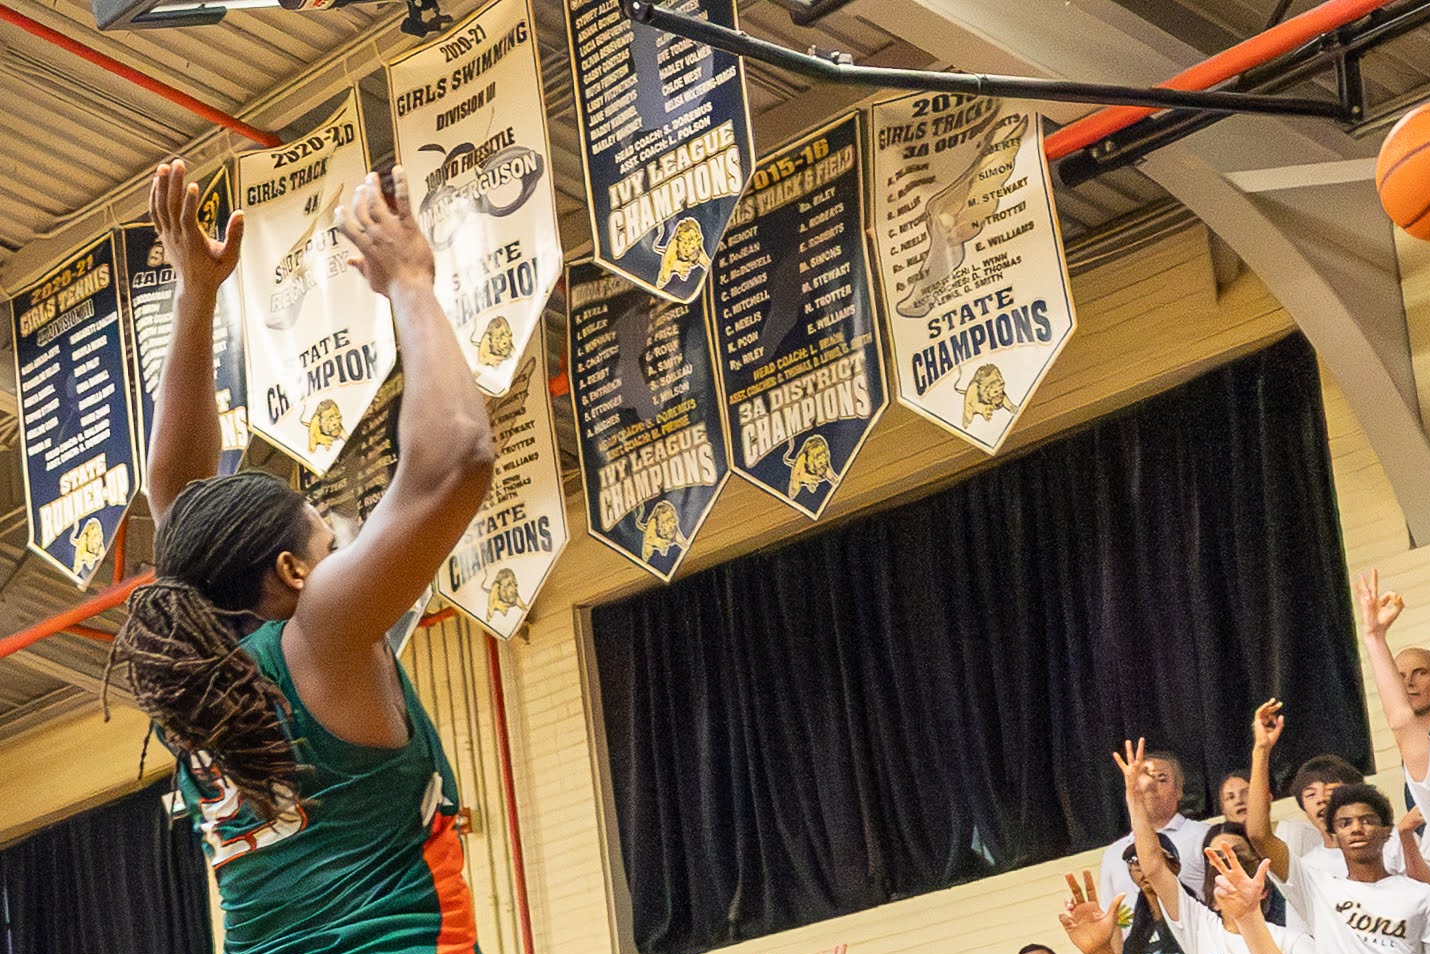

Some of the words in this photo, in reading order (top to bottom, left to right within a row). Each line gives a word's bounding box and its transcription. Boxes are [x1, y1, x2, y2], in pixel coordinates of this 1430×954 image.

[440, 23, 487, 63] 2020-21
[397, 78, 447, 117] GIRLS
[451, 21, 528, 91] SWIMMING
[436, 88, 485, 132] DIVISION
[677, 115, 711, 142] POLSON
[879, 121, 927, 150] GIRLS
[247, 176, 286, 207] GIRLS
[290, 157, 329, 192] TRACK
[609, 168, 645, 210] IVY
[646, 119, 735, 188] LEAGUE
[752, 138, 830, 191] 015-16
[756, 171, 803, 217] TRACK
[816, 144, 855, 186] FIELD
[982, 176, 1029, 203] STEWART
[609, 144, 743, 260] CHAMPIONS
[986, 221, 1035, 248] WILLIAMS
[20, 297, 56, 337] GIRLS
[58, 263, 109, 312] TENNIS
[812, 262, 851, 288] STEWART
[815, 285, 853, 311] TROTTER
[817, 305, 856, 330] WILLIAMS
[928, 286, 1015, 339] STATE
[299, 328, 350, 368] TATE
[912, 299, 1052, 396] CHAMPIONS
[768, 350, 867, 413] DISTRICT
[742, 374, 871, 469] CHAMPIONS
[60, 453, 107, 496] STATE
[503, 451, 539, 473] WILLIAMS
[598, 457, 629, 488] IVY
[629, 422, 708, 472] LEAGUE
[39, 463, 129, 549] RUNNER-UP
[599, 443, 718, 532] CHAMPIONS
[449, 516, 553, 593] CHAMPIONS
[1336, 901, 1406, 939] Lions
